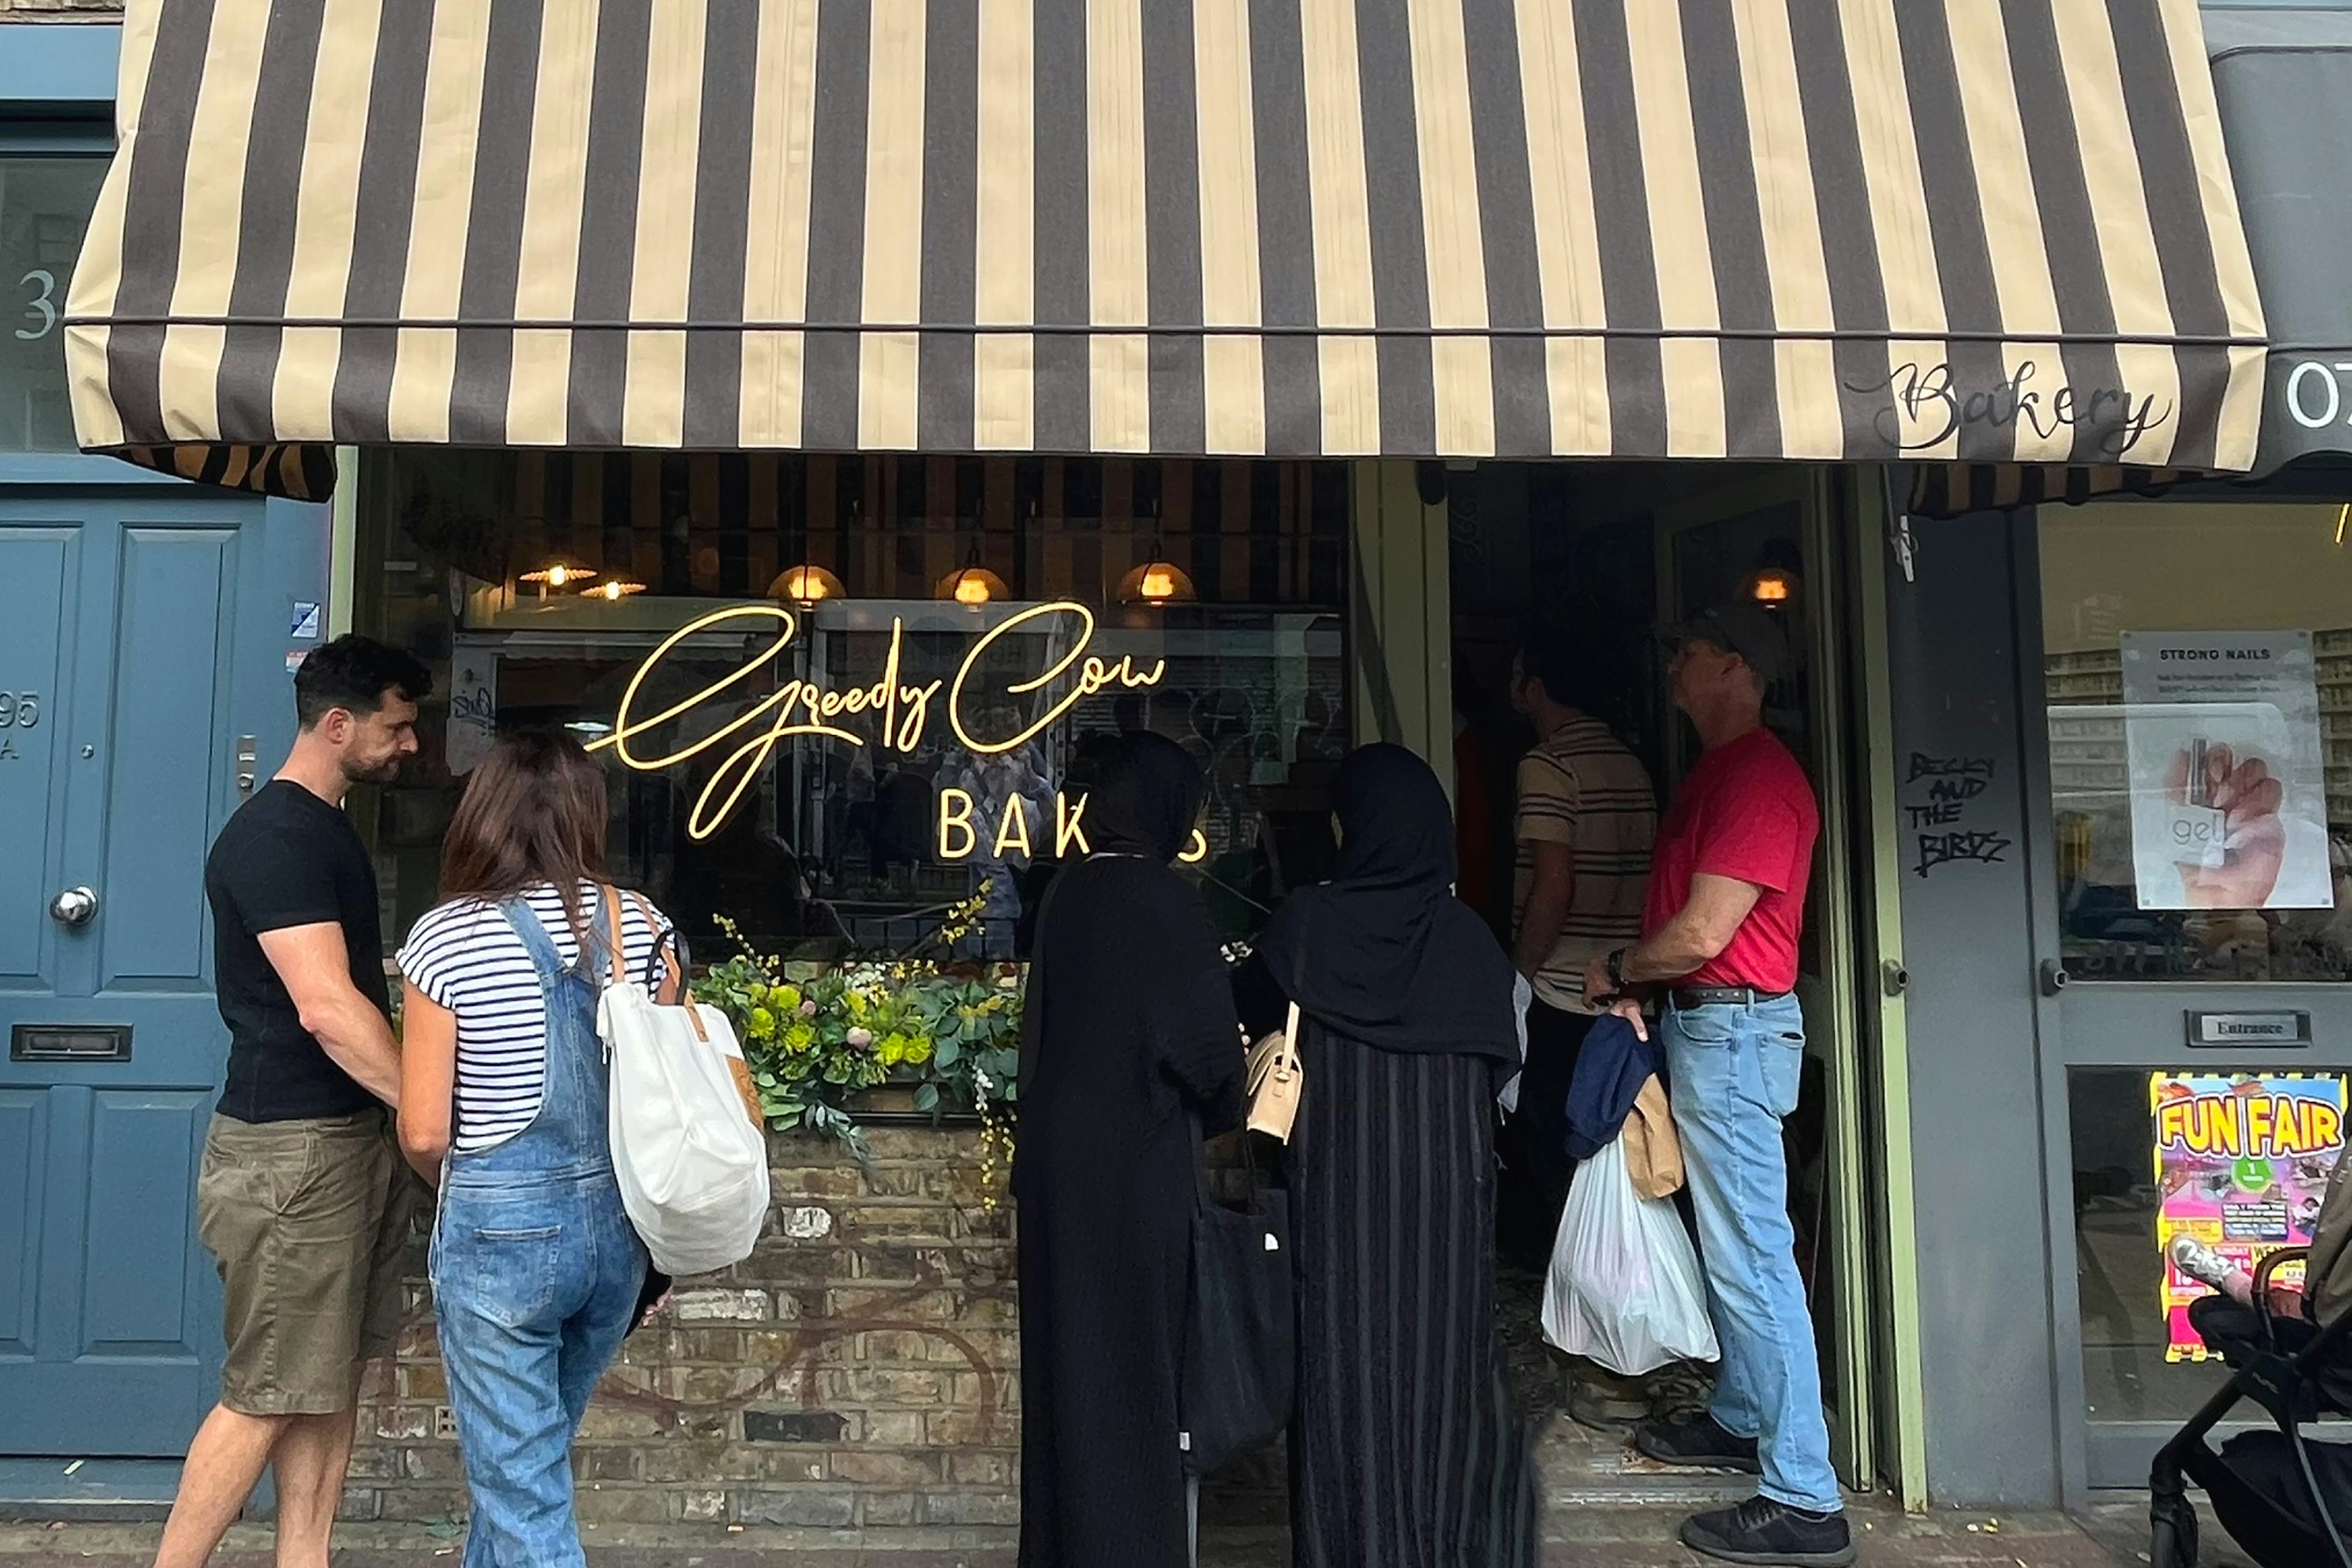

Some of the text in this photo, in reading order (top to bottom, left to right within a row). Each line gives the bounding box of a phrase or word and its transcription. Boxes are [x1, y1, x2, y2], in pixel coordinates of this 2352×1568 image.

[15, 270, 56, 340] 3
[1843, 360, 2172, 454] Bakery
[2226, 649, 2271, 660] NAILS
[584, 602, 1166, 840] Greedy Cow
[1930, 777, 1987, 801] AND
[939, 788, 1207, 862] BAK
[1904, 802, 1963, 829] THE
[2173, 813, 2222, 845] gel
[2217, 1021, 2283, 1035] Entrance
[2159, 1095, 2342, 1156] FUN FAIR
